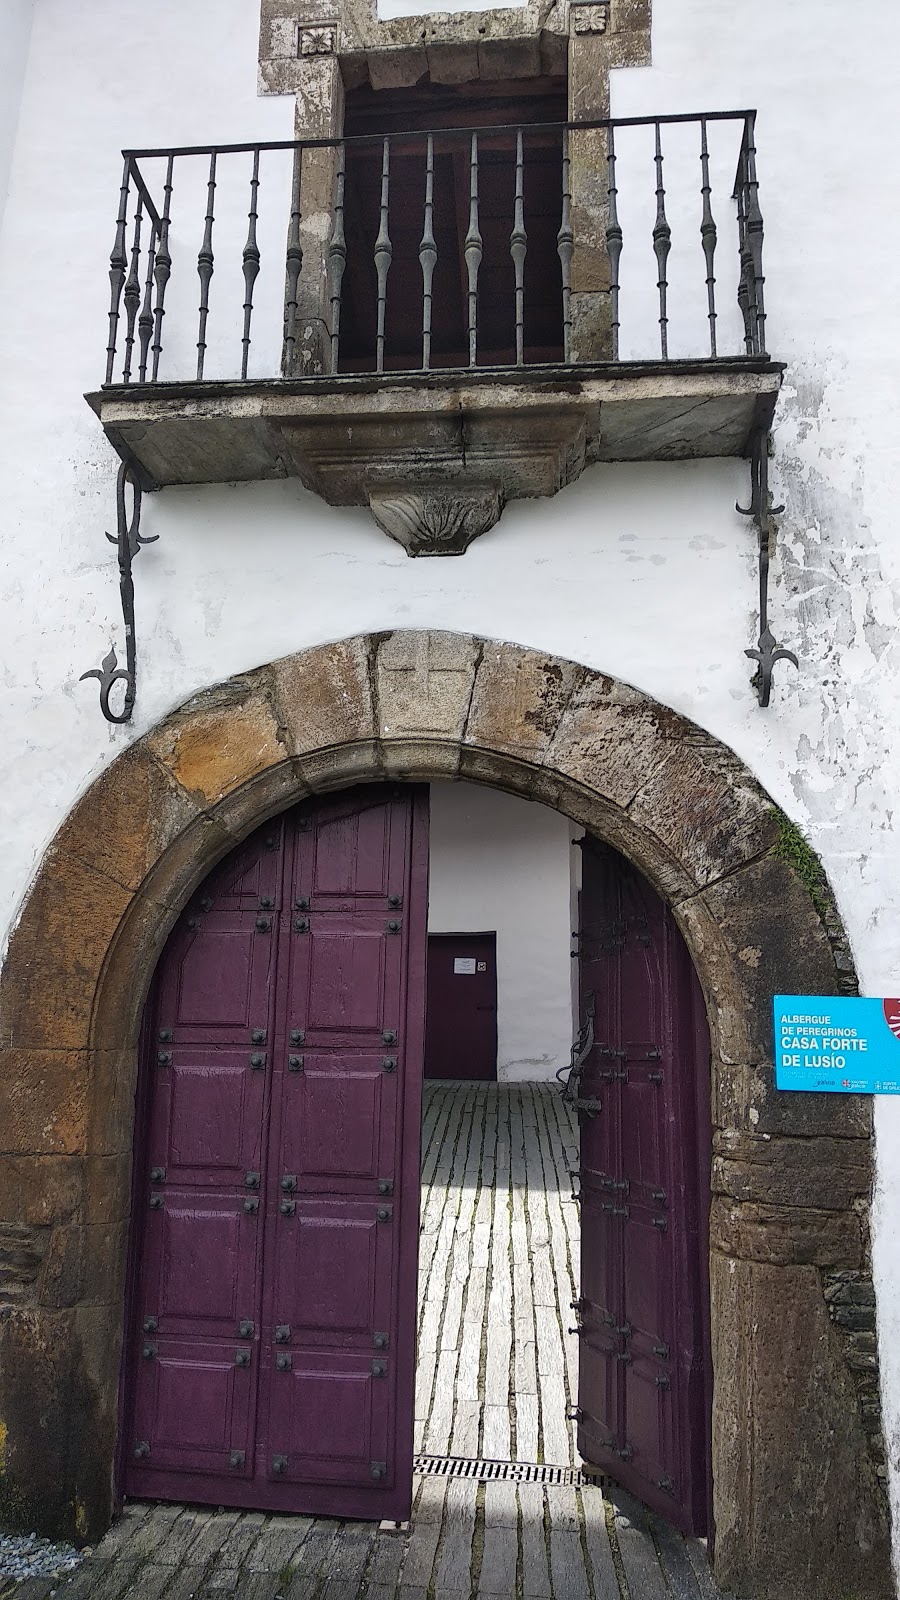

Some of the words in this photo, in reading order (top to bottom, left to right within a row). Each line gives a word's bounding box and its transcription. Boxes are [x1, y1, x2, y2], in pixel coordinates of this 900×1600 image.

[781, 1015, 831, 1025] ALBERGUE
[782, 1027, 794, 1035] DE
[797, 1027, 857, 1037] PEREGRINOS
[782, 1037, 818, 1049] CASA
[823, 1038, 868, 1051] FORTE
[782, 1055, 800, 1067] DE
[804, 1053, 846, 1069] LUSÍO
